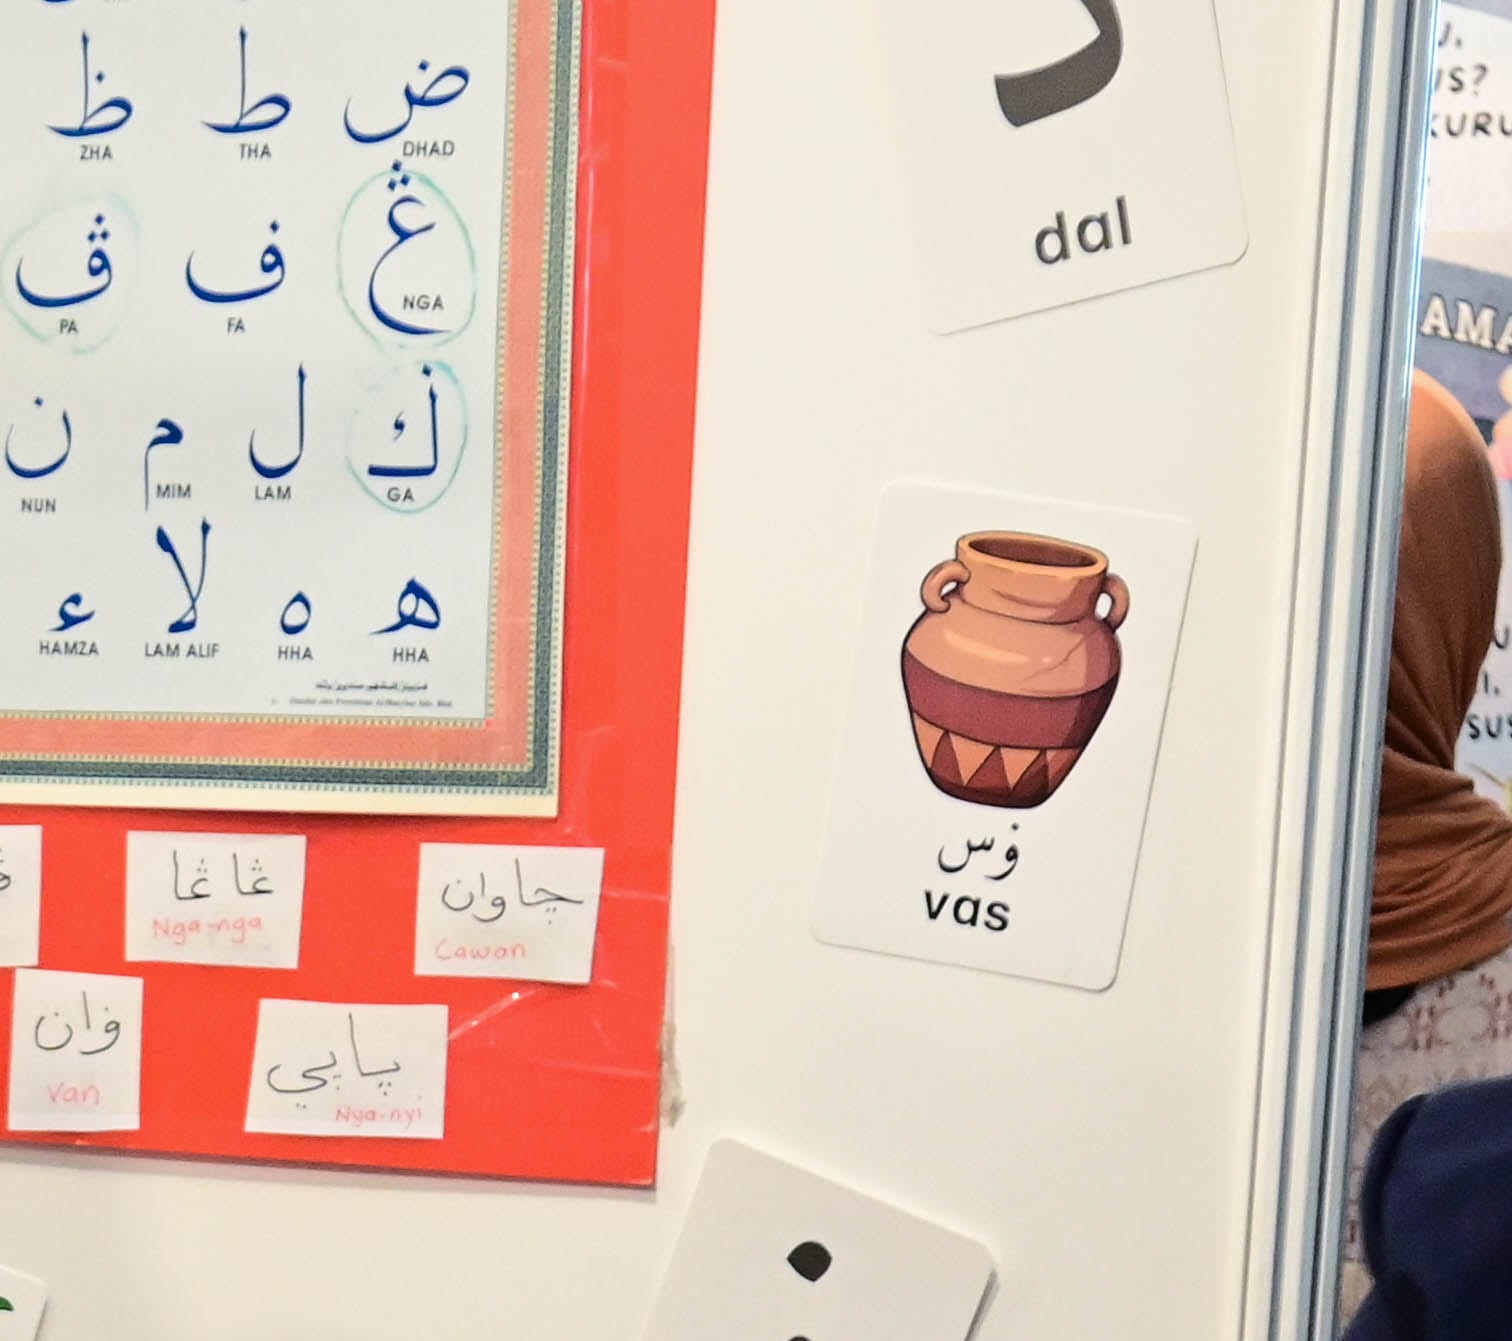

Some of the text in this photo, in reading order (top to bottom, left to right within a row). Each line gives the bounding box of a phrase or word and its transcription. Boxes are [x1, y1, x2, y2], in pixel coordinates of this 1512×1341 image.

[45, 30, 134, 138] ظ
[200, 26, 293, 134] ط
[342, 57, 471, 145] ض
[79, 144, 114, 162] ZHA
[238, 143, 273, 161] THA
[402, 140, 456, 158] DHAD
[1035, 196, 1131, 264] dal
[185, 221, 287, 304] ف
[402, 294, 445, 312] NGA
[59, 318, 79, 335] PA
[226, 317, 246, 333] FA
[248, 362, 306, 479] ل
[4, 396, 73, 479] ن
[144, 417, 185, 512] م
[154, 482, 193, 500] MIM
[253, 484, 293, 502] LAM
[386, 486, 416, 504] GA
[20, 496, 57, 514] NUN
[154, 517, 213, 636] لا
[48, 590, 98, 634] ء
[38, 640, 101, 657] HAMZA
[145, 643, 218, 658] LAM ALIF
[276, 644, 315, 662] HHA
[391, 646, 431, 663] HHA
[925, 891, 1009, 931] vas
[434, 937, 528, 962] Cawan
